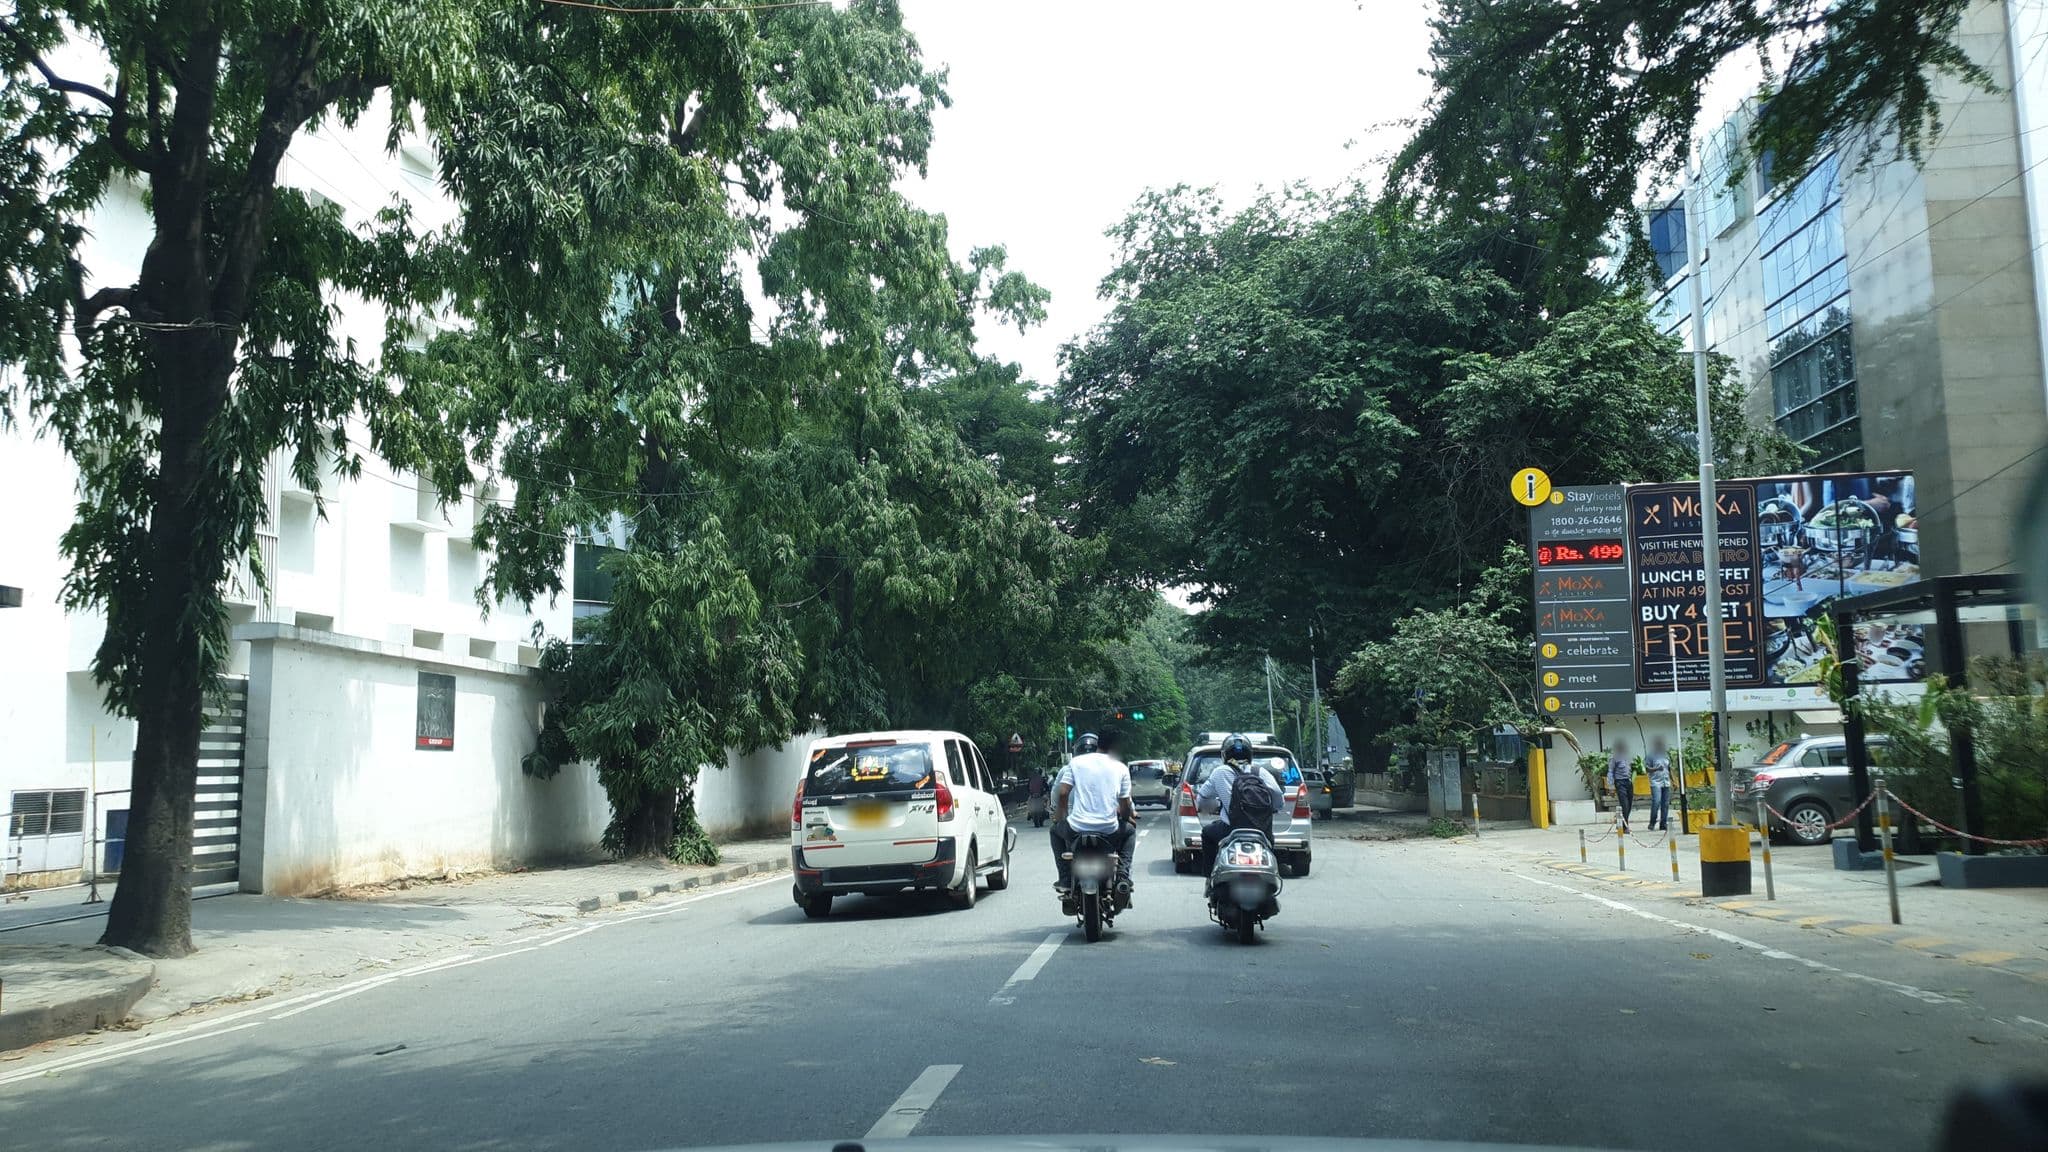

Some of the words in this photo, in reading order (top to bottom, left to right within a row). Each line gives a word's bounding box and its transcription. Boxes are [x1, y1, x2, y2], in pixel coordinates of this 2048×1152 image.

[1574, 505, 1604, 514] infantry
[1605, 503, 1622, 511] road
[1551, 515, 1622, 526] 1800-26-62646
[1673, 520, 1720, 528] BISTO
[1640, 541, 1660, 550] VISIT
[1662, 540, 1679, 549] THE
[1681, 539, 1704, 549] NEWL
[1719, 537, 1749, 547] PENED
[1555, 545, 1584, 560] Rs.
[1588, 544, 1623, 559] 499
[1641, 552, 1690, 566] MOXA
[1692, 549, 1750, 564] BTRO
[1641, 570, 1693, 584] LUNCH
[1697, 567, 1750, 582] BFFET
[1642, 587, 1659, 599] AT
[1662, 586, 1686, 598] INR
[1642, 604, 1681, 621] BUY
[1685, 603, 1697, 619] 4
[1745, 601, 1752, 617] 1
[1643, 621, 1755, 657] FREE!
[1567, 645, 1619, 656] celebrate
[1568, 674, 1598, 683] meet
[1569, 697, 1596, 709] train
